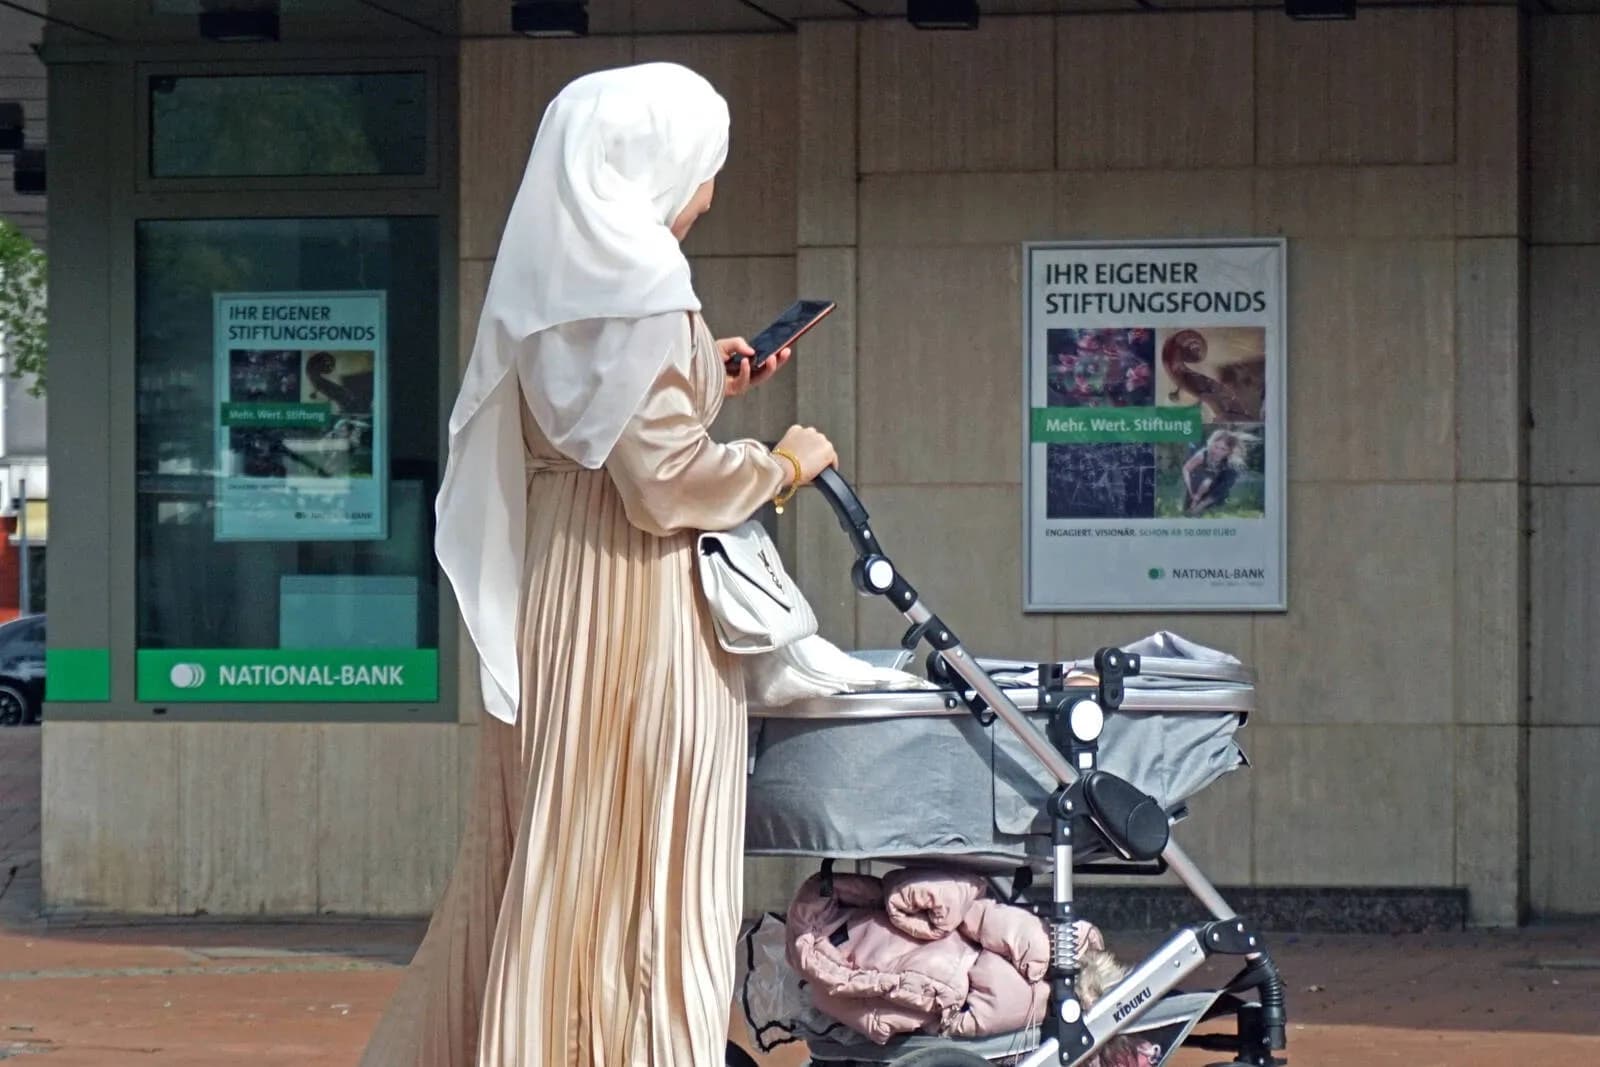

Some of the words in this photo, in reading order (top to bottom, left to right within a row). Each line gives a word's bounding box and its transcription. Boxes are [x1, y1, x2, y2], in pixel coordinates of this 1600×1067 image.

[1046, 263, 1088, 285] IHR
[1095, 262, 1199, 285] EIGENER
[1046, 291, 1266, 314] STIFTUNGSFONDS
[229, 306, 257, 320] IHR
[262, 305, 331, 320] EIGENER
[228, 325, 375, 341] STIFTUNGSFONDS
[286, 409, 325, 422] Stiftung
[1046, 419, 1088, 432] Mehr.
[1091, 419, 1130, 432] Wert.
[1134, 418, 1193, 434] Stiftung
[1172, 568, 1265, 579] NATIONAL-BANK
[219, 665, 404, 686] NATIONAL-BANK
[1113, 987, 1151, 1022] KIDUKU
